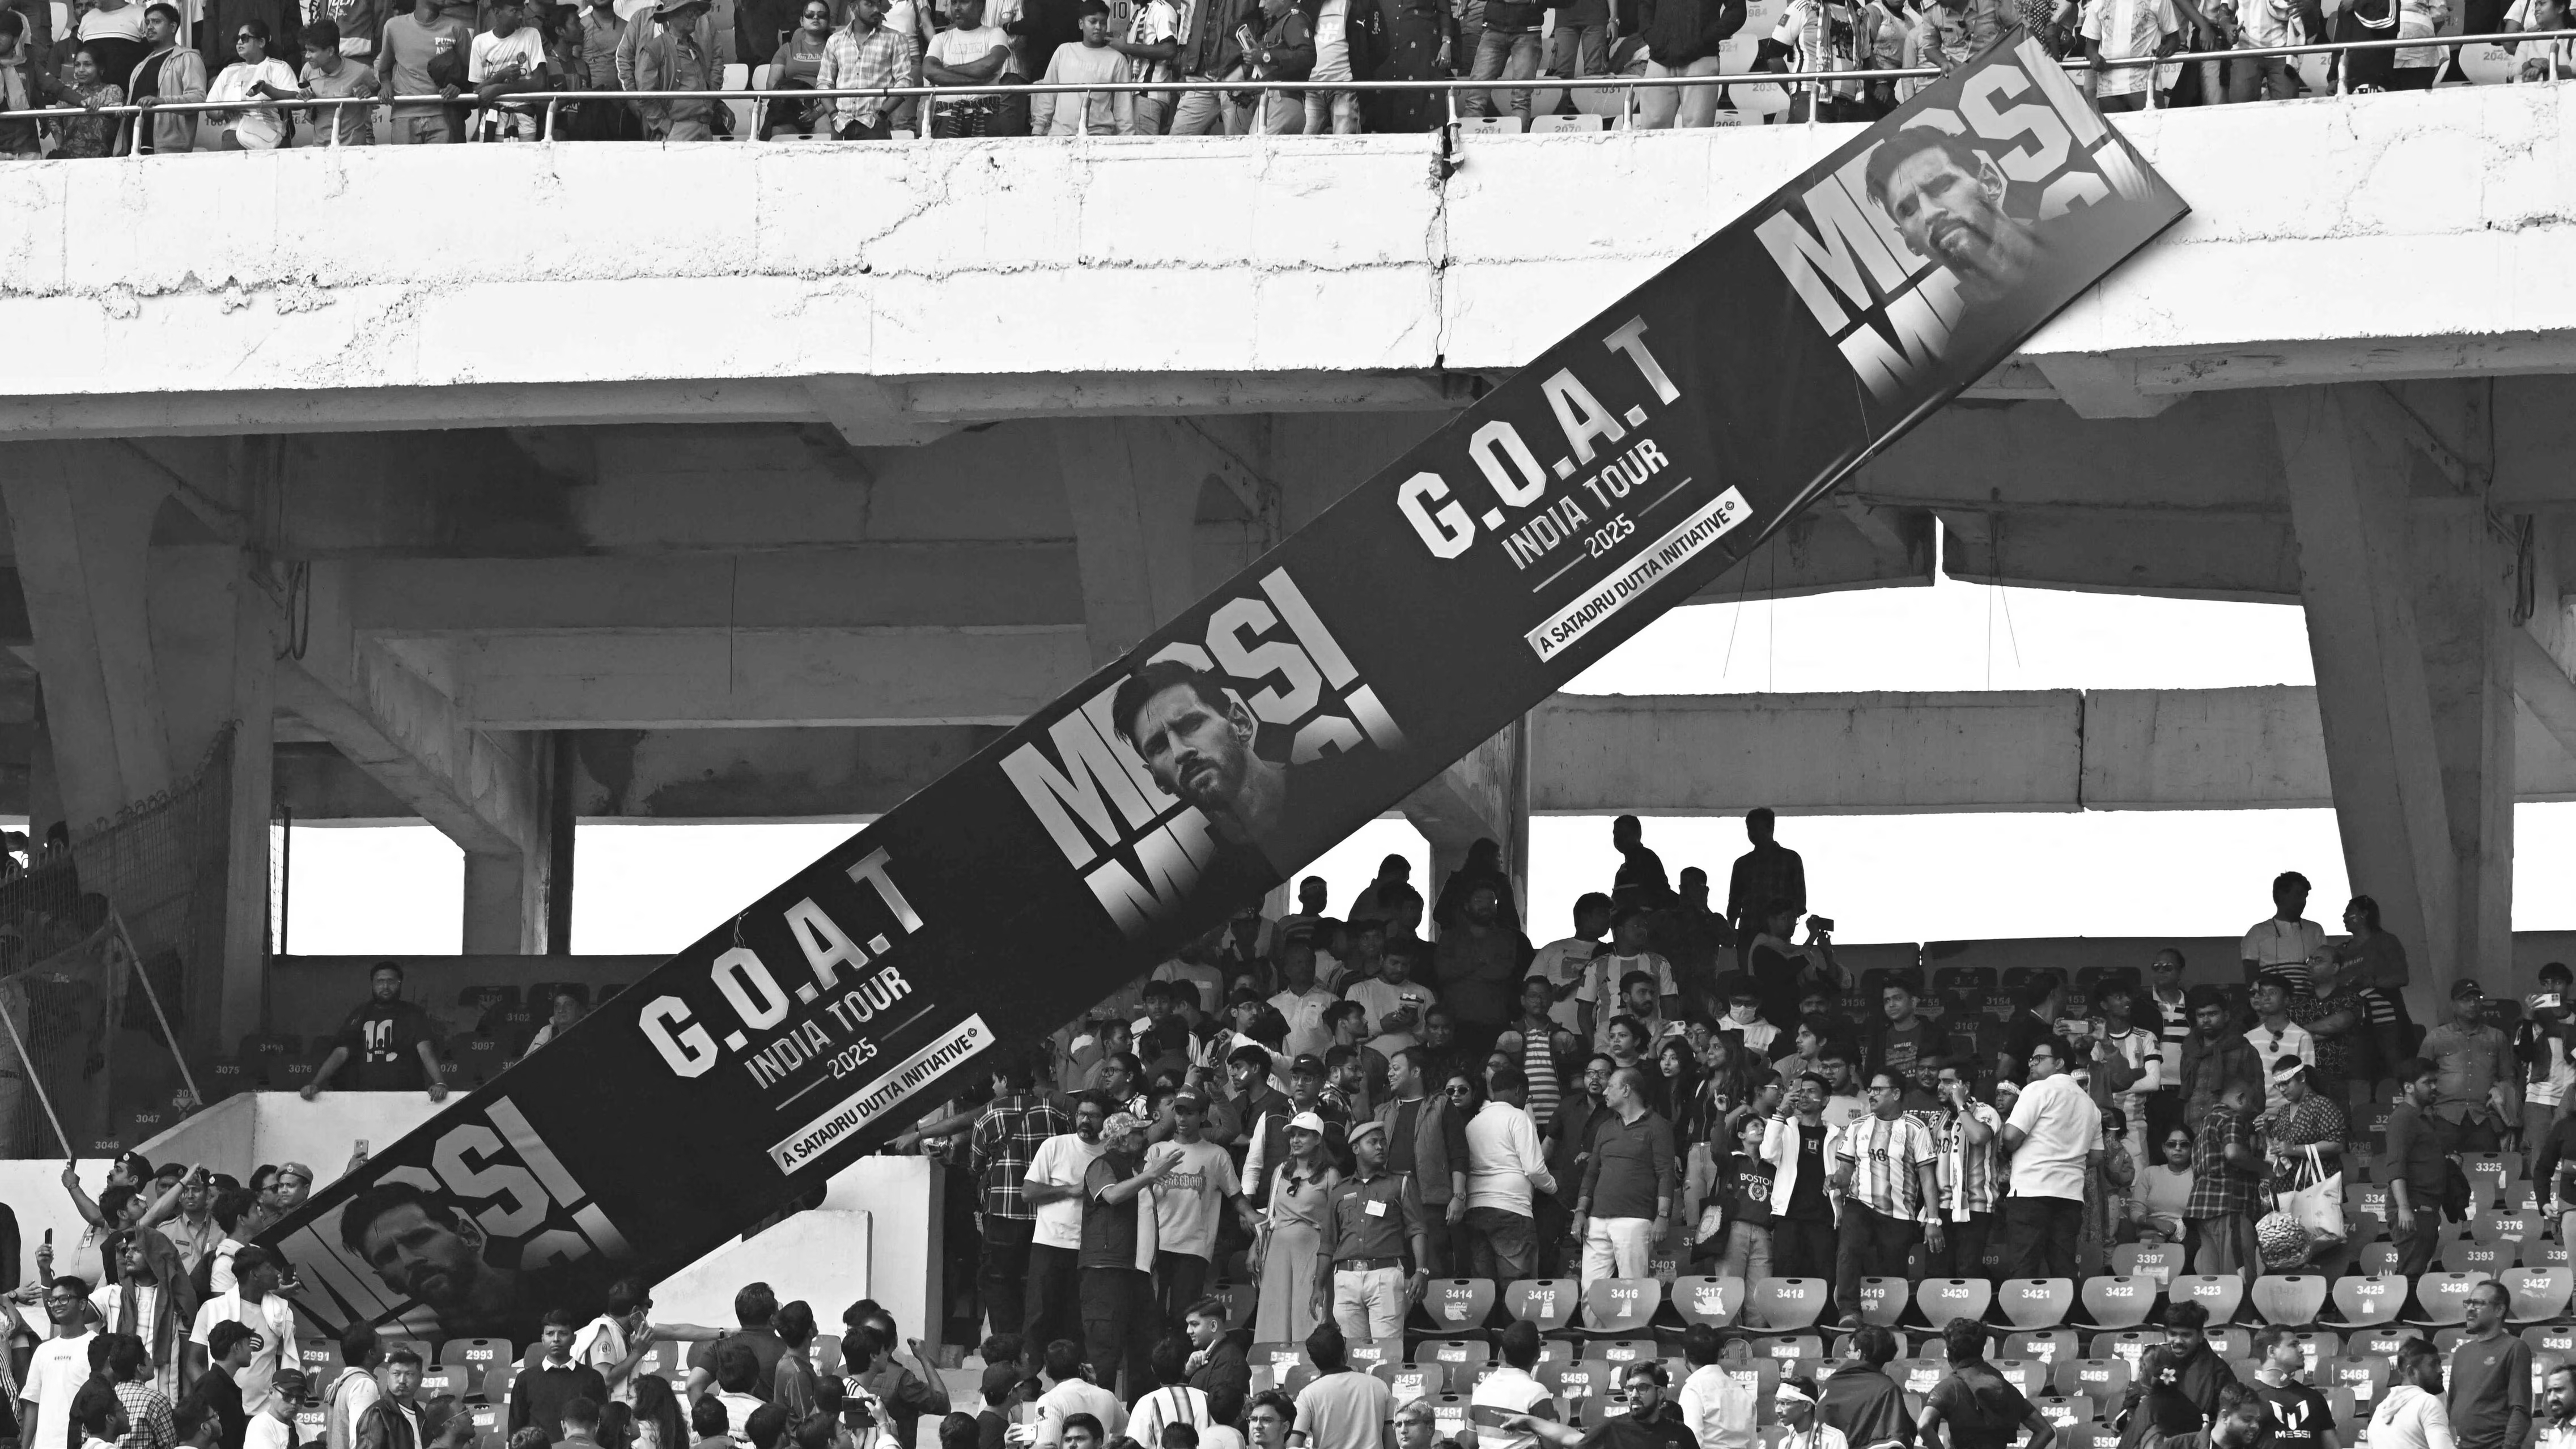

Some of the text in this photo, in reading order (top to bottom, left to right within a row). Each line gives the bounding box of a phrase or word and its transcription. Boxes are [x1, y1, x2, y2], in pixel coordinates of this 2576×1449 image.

[1113, 1, 1127, 19] 10
[1754, 36, 2107, 337] MSI
[1397, 315, 1680, 559] G.O.A.T
[1501, 439, 1669, 570] INDIA TOUR
[1585, 513, 1635, 558] 2025
[1539, 636, 1554, 653] A
[1551, 590, 1616, 643] SATADRU
[1615, 560, 1663, 599] DUTTA
[999, 566, 1359, 870] MSI
[639, 845, 923, 1077] G.O.A.T
[2068, 996, 2086, 1005] 153
[745, 966, 911, 1089] INDIA TOUR
[471, 1042, 495, 1051] 3097
[827, 1037, 877, 1079] 2025
[216, 1065, 240, 1074] 3075
[288, 1065, 312, 1074] 3076
[440, 1064, 458, 1073] 078
[136, 1114, 160, 1123] 3047
[782, 1151, 796, 1166] A
[793, 1110, 858, 1157] SATADRU
[857, 1081, 906, 1118] DUTTA
[95, 1141, 119, 1150] 3046
[2476, 1162, 2502, 1172] 3325
[1740, 1173, 1774, 1187] BOSTON
[2365, 1193, 2385, 1203] 334
[2496, 1220, 2523, 1230] 3376
[2137, 1253, 2165, 1264] 3397
[2467, 1251, 2494, 1261] 3393
[2547, 1251, 2567, 1260] 339
[1650, 1260, 1676, 1269] 3403
[2441, 1283, 2469, 1293] 3426
[2523, 1278, 2551, 1288] 3427
[1446, 1289, 1473, 1299] 3414
[1528, 1290, 1555, 1300] 3415
[1611, 1289, 1638, 1299] 3416
[1695, 1287, 1723, 1297] 3417
[1777, 1289, 1804, 1298] 3418
[1942, 1288, 1969, 1298] 3420
[2022, 1289, 2051, 1299] 3421
[2106, 1286, 2134, 1297] 3422
[2193, 1285, 2221, 1295] 3423
[2357, 1285, 2384, 1295] 3425
[2371, 1340, 2400, 1352] 3441
[2543, 1337, 2572, 1349] 3439
[303, 1350, 329, 1361] 2991
[466, 1350, 493, 1360] 2993
[1353, 1348, 1381, 1359] 3453
[1395, 1374, 1422, 1384] 3457
[1561, 1372, 1589, 1384] 3459
[1730, 1371, 1758, 1382] 3461
[1911, 1369, 1940, 1380] 3463
[2080, 1370, 2109, 1382] 3465
[2340, 1369, 2369, 1380] 3468
[421, 1377, 448, 1388] 2974
[1434, 1407, 1462, 1418] 3491
[2041, 1406, 2070, 1417] 3484
[296, 1413, 324, 1423] 2964
[2274, 1430, 2311, 1439] MESSI
